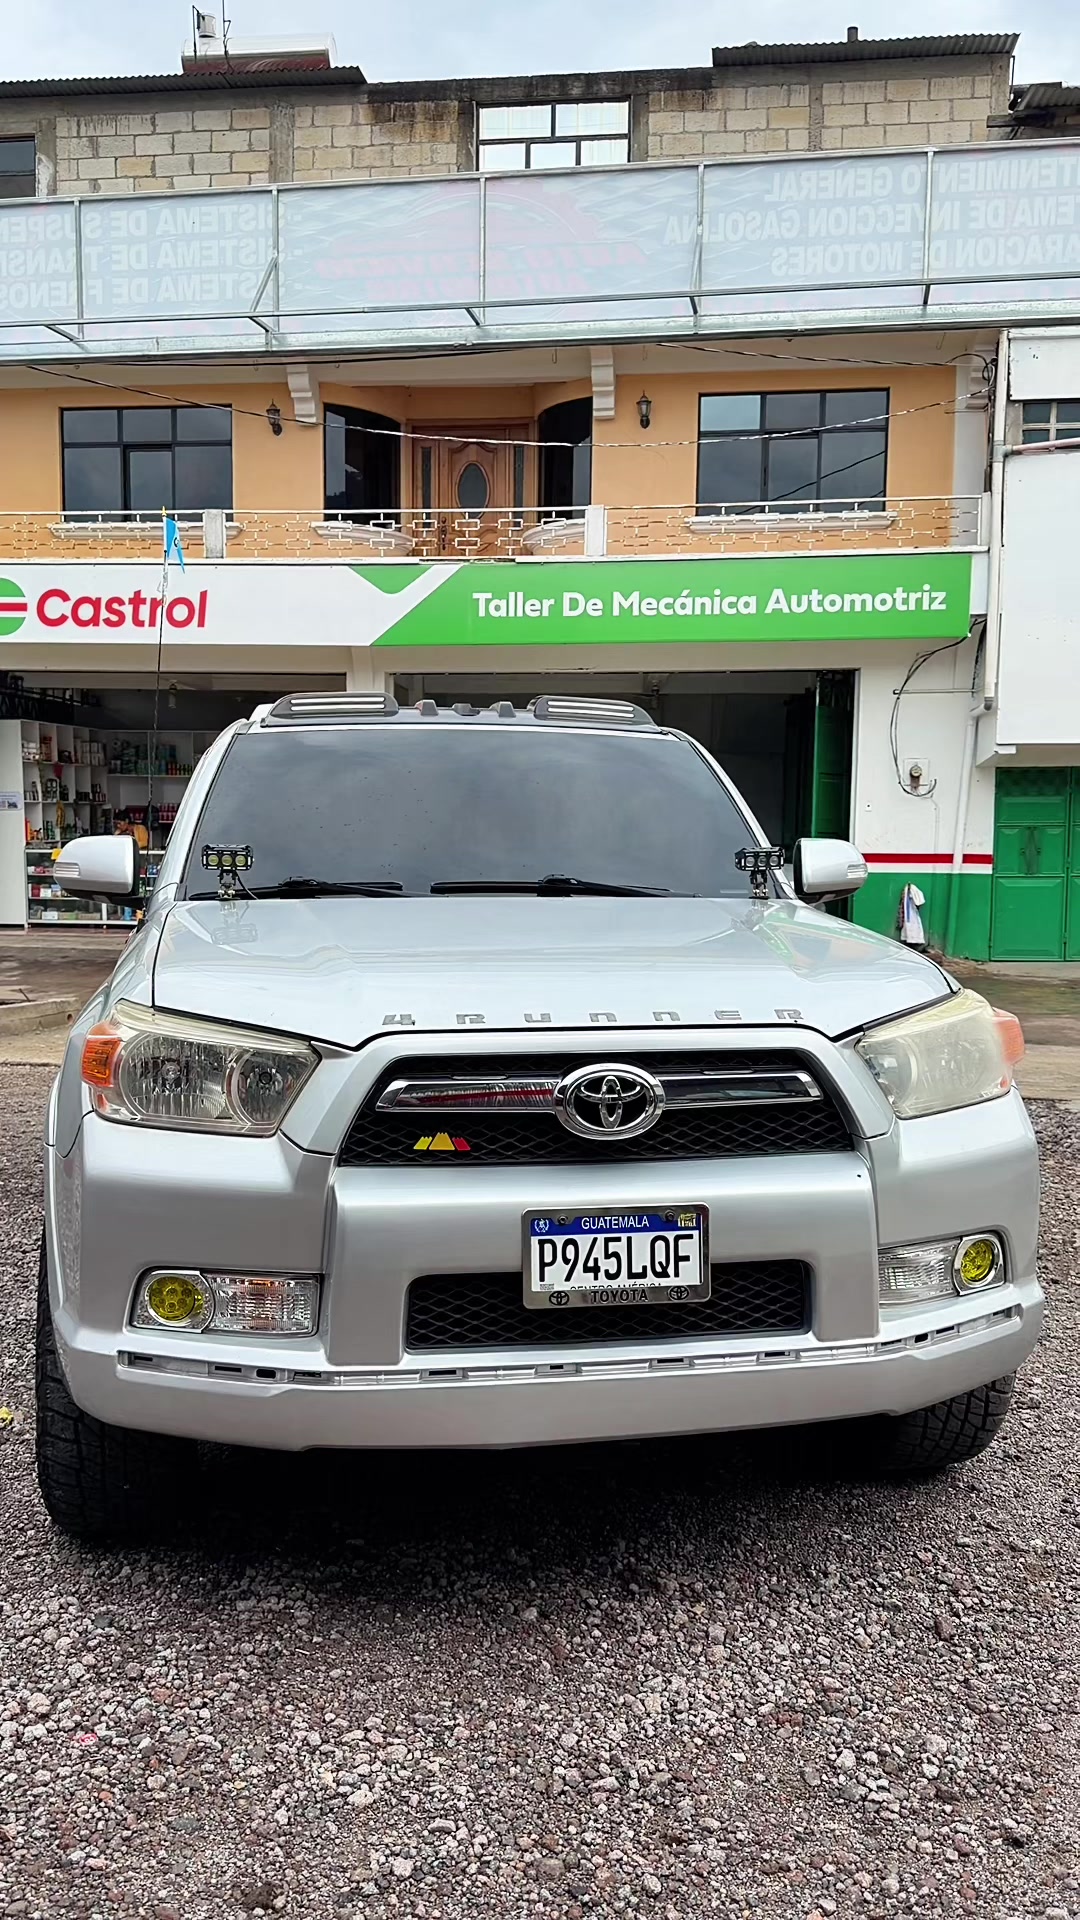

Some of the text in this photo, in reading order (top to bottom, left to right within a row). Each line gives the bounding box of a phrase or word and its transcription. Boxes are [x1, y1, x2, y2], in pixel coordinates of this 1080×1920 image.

[36, 588, 208, 628] Castrol
[472, 584, 947, 618] Taller De Mecánica Automotriz
[581, 1215, 650, 1230] GUATEMALA
[537, 1233, 694, 1283] P945LQF
[591, 1288, 648, 1303] TOYOTA
